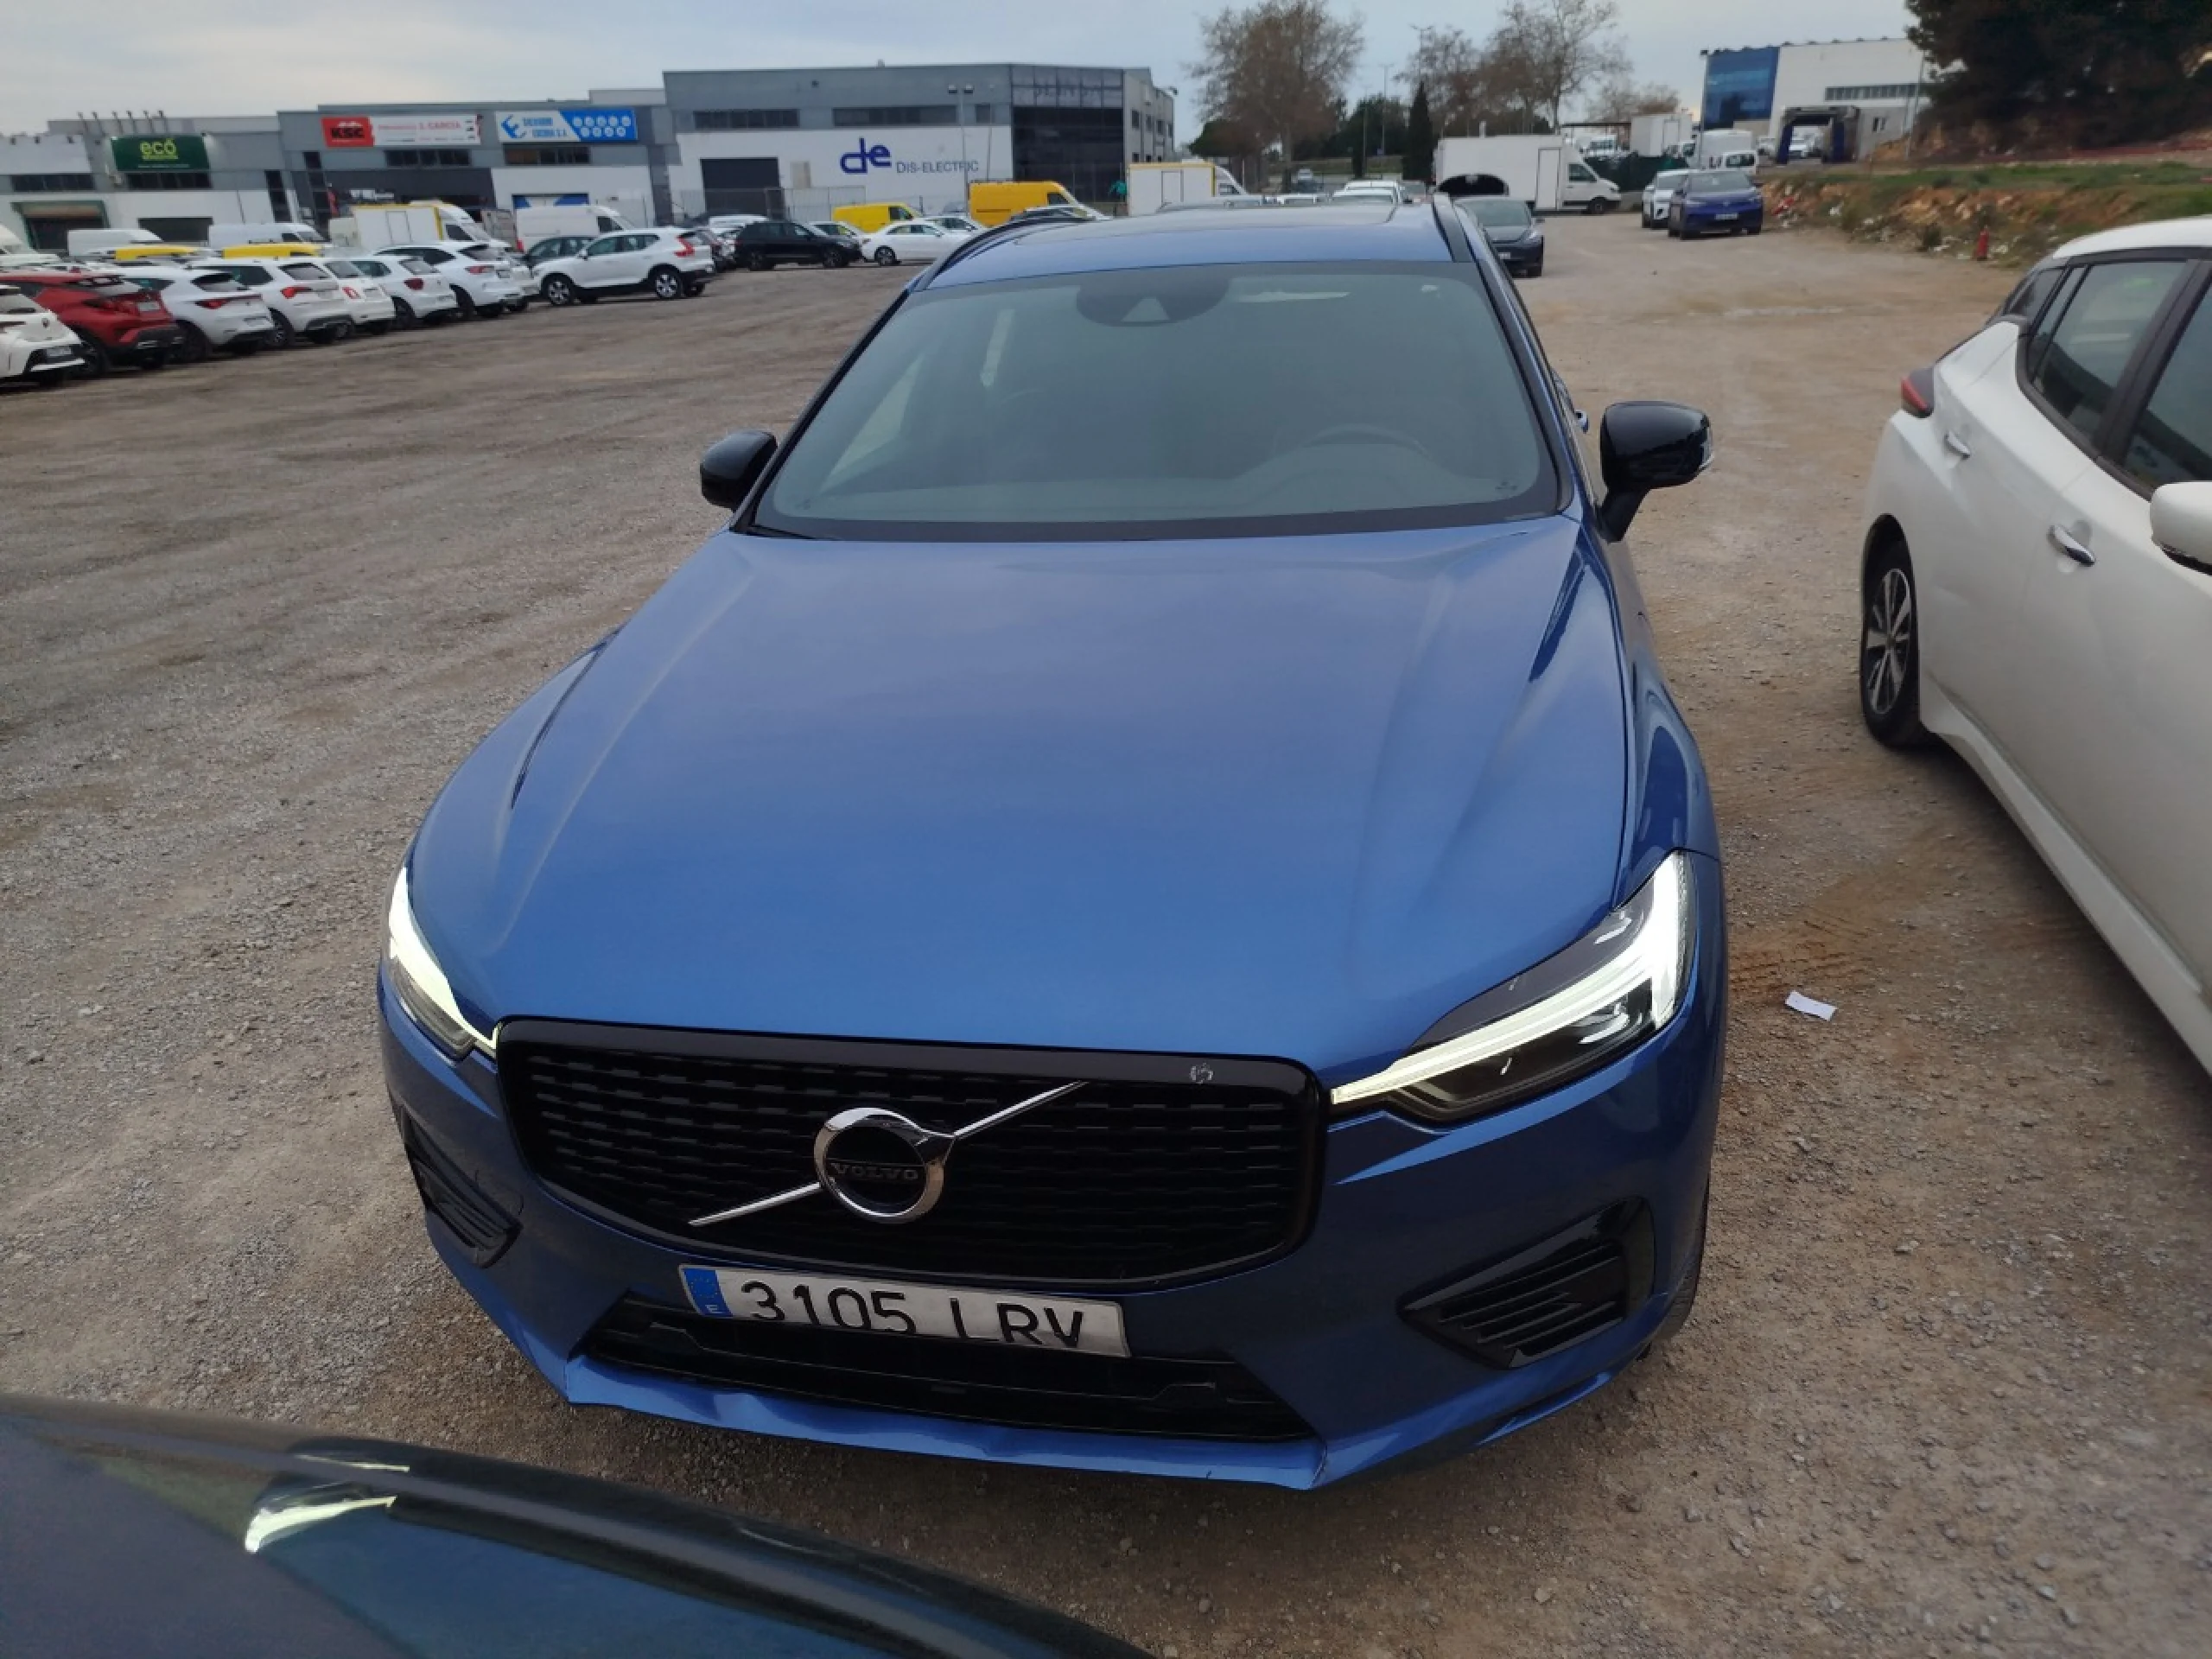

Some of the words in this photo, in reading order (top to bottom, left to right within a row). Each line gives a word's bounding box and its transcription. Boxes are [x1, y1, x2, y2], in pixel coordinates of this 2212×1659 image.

[840, 137, 892, 174] de
[896, 160, 979, 173] DIS-ELECTRIC
[830, 1162, 918, 1179] VOLVO
[741, 1280, 917, 1335] 3105
[950, 1297, 1084, 1349] LRV
